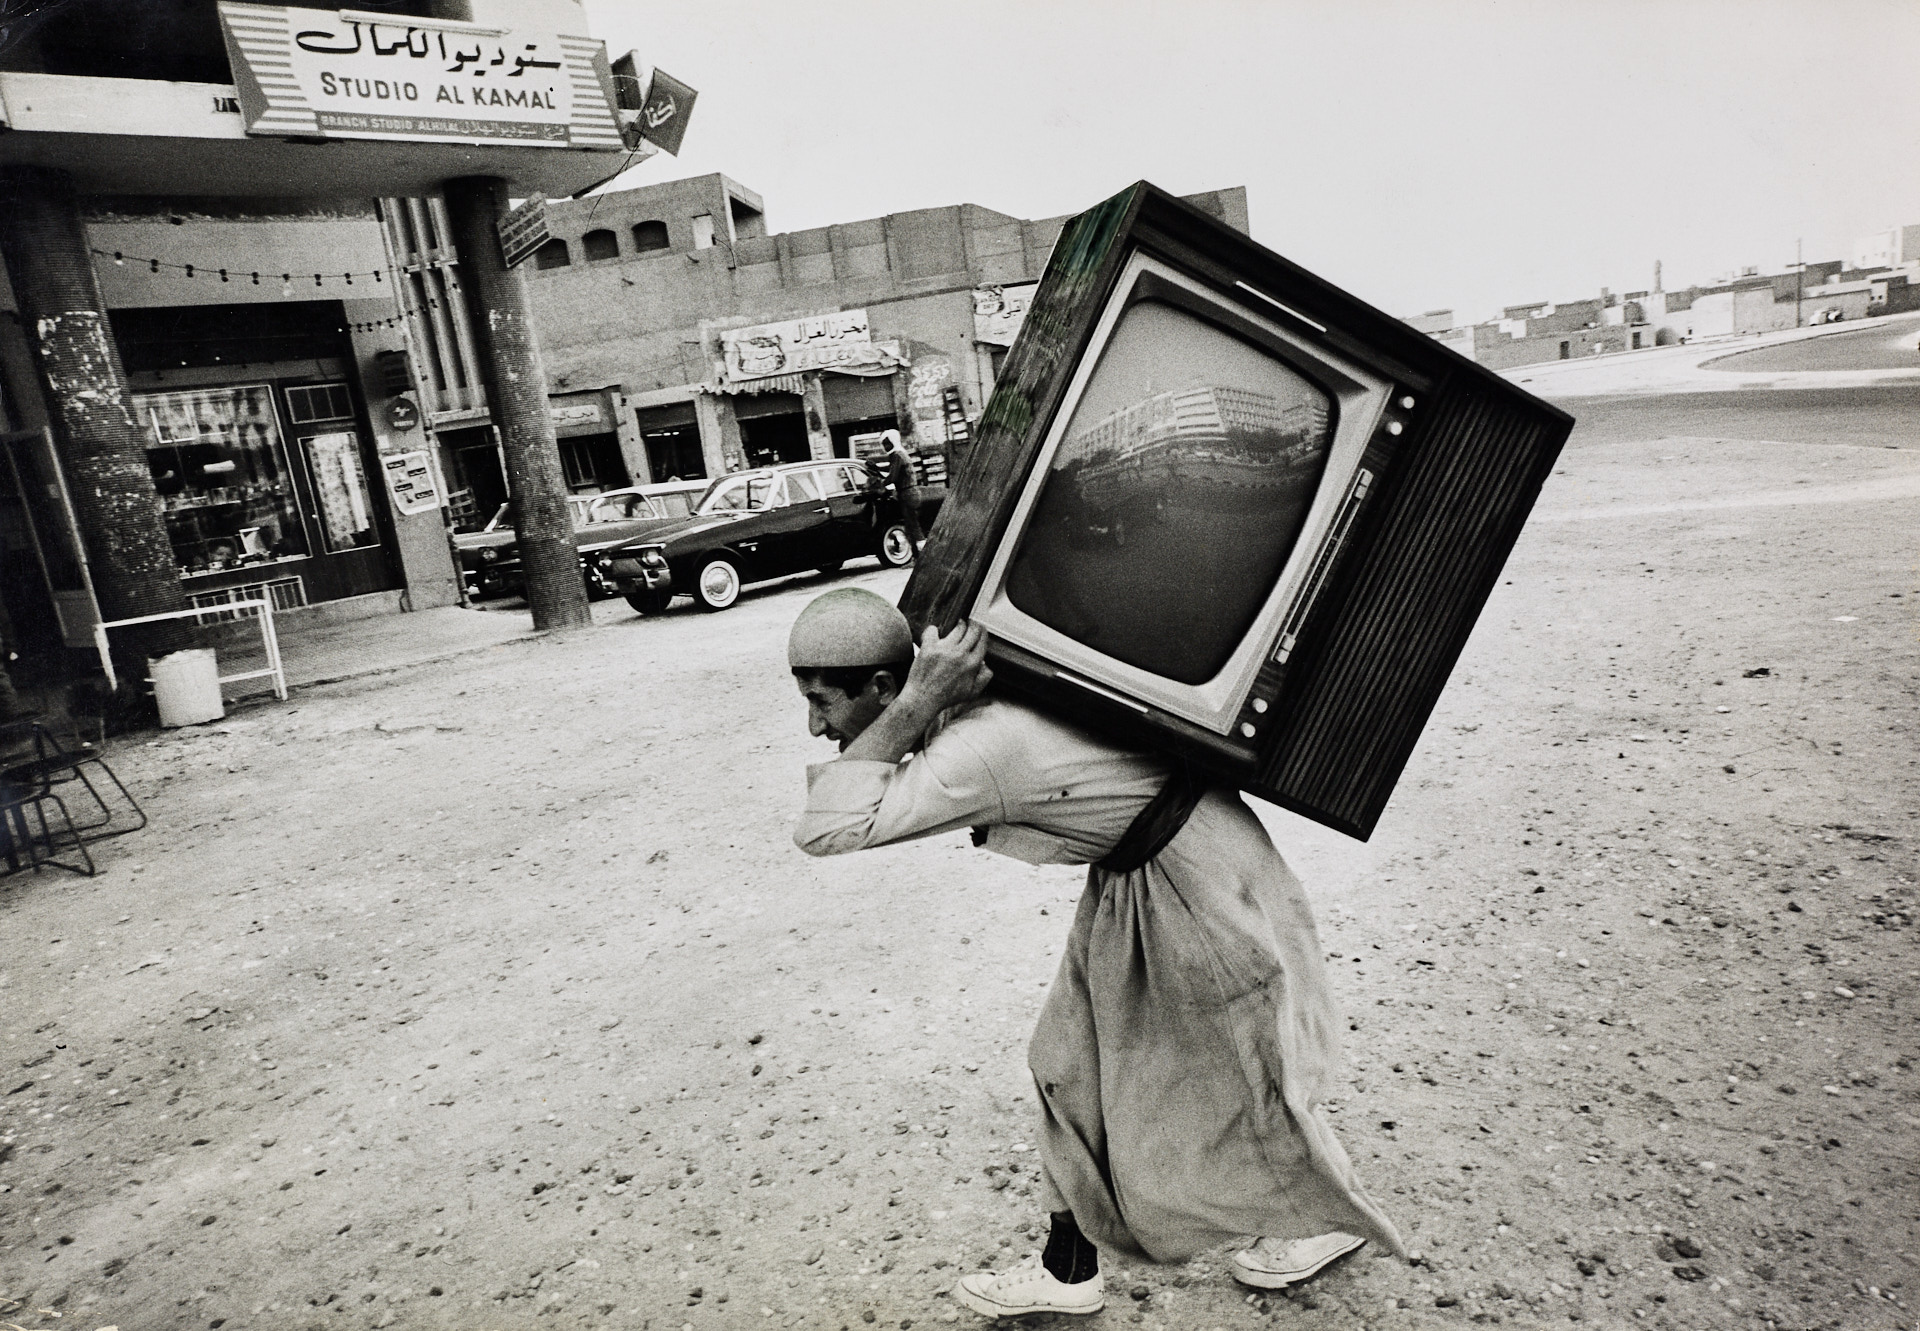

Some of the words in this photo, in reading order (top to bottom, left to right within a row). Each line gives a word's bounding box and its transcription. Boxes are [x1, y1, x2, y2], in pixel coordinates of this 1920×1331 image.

[296, 21, 446, 60] الكمال
[446, 44, 561, 76] ستوديو
[320, 71, 418, 101] STUDIO
[436, 84, 465, 105] AL
[471, 87, 556, 110] KAMAL
[321, 115, 367, 128] BRANCH
[370, 118, 413, 130] STUDIO
